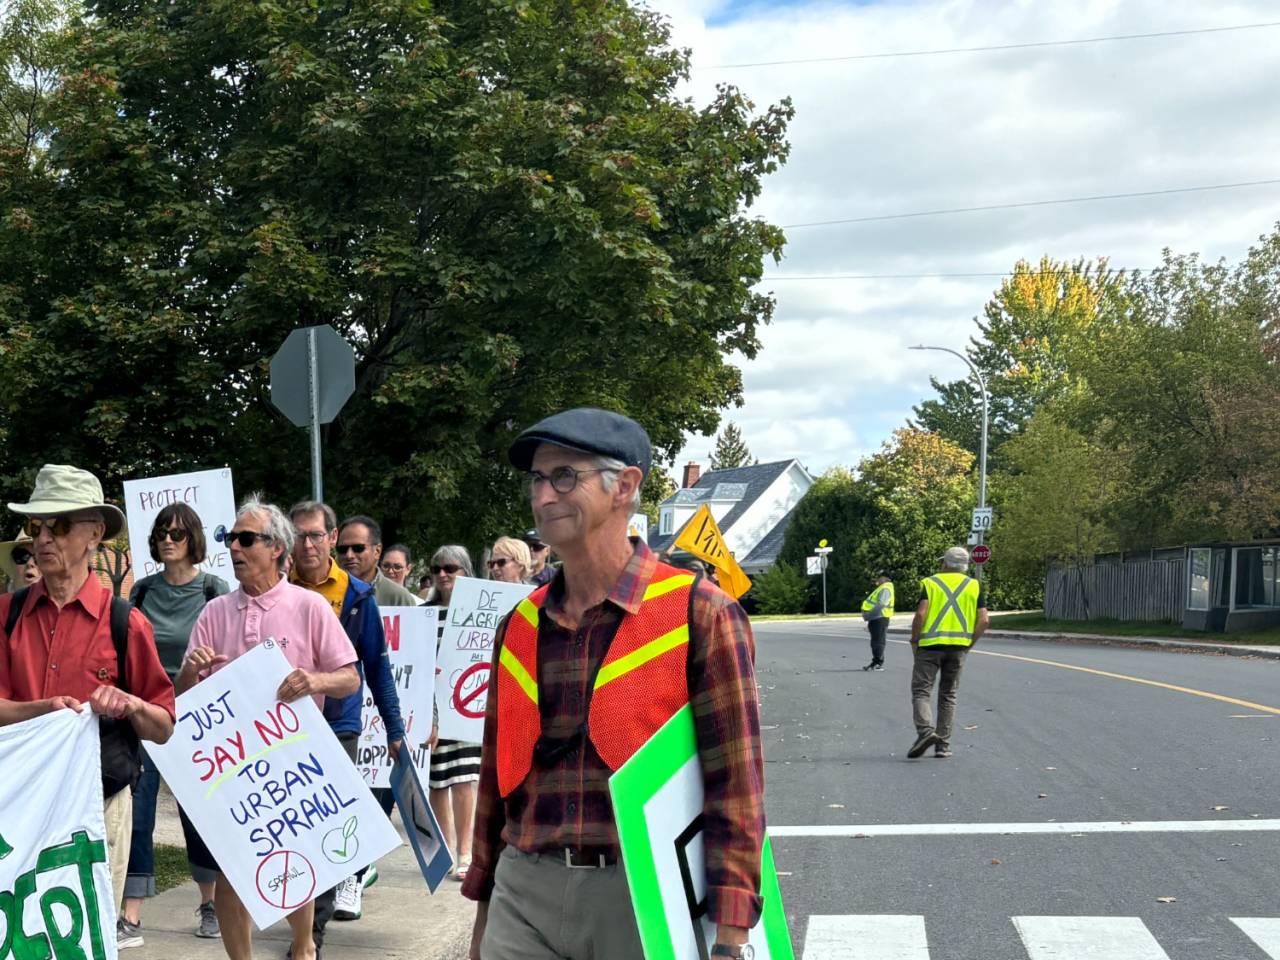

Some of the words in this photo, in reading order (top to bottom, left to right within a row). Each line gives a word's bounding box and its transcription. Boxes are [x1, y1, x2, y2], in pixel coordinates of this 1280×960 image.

[974, 515, 990, 527] 30
[477, 589, 503, 610] DE
[178, 690, 235, 741] JUST
[192, 730, 245, 782] SAY
[254, 702, 300, 746] NO
[230, 752, 324, 826] URBAN
[237, 759, 270, 783] TO
[249, 783, 359, 857] SPRAWL
